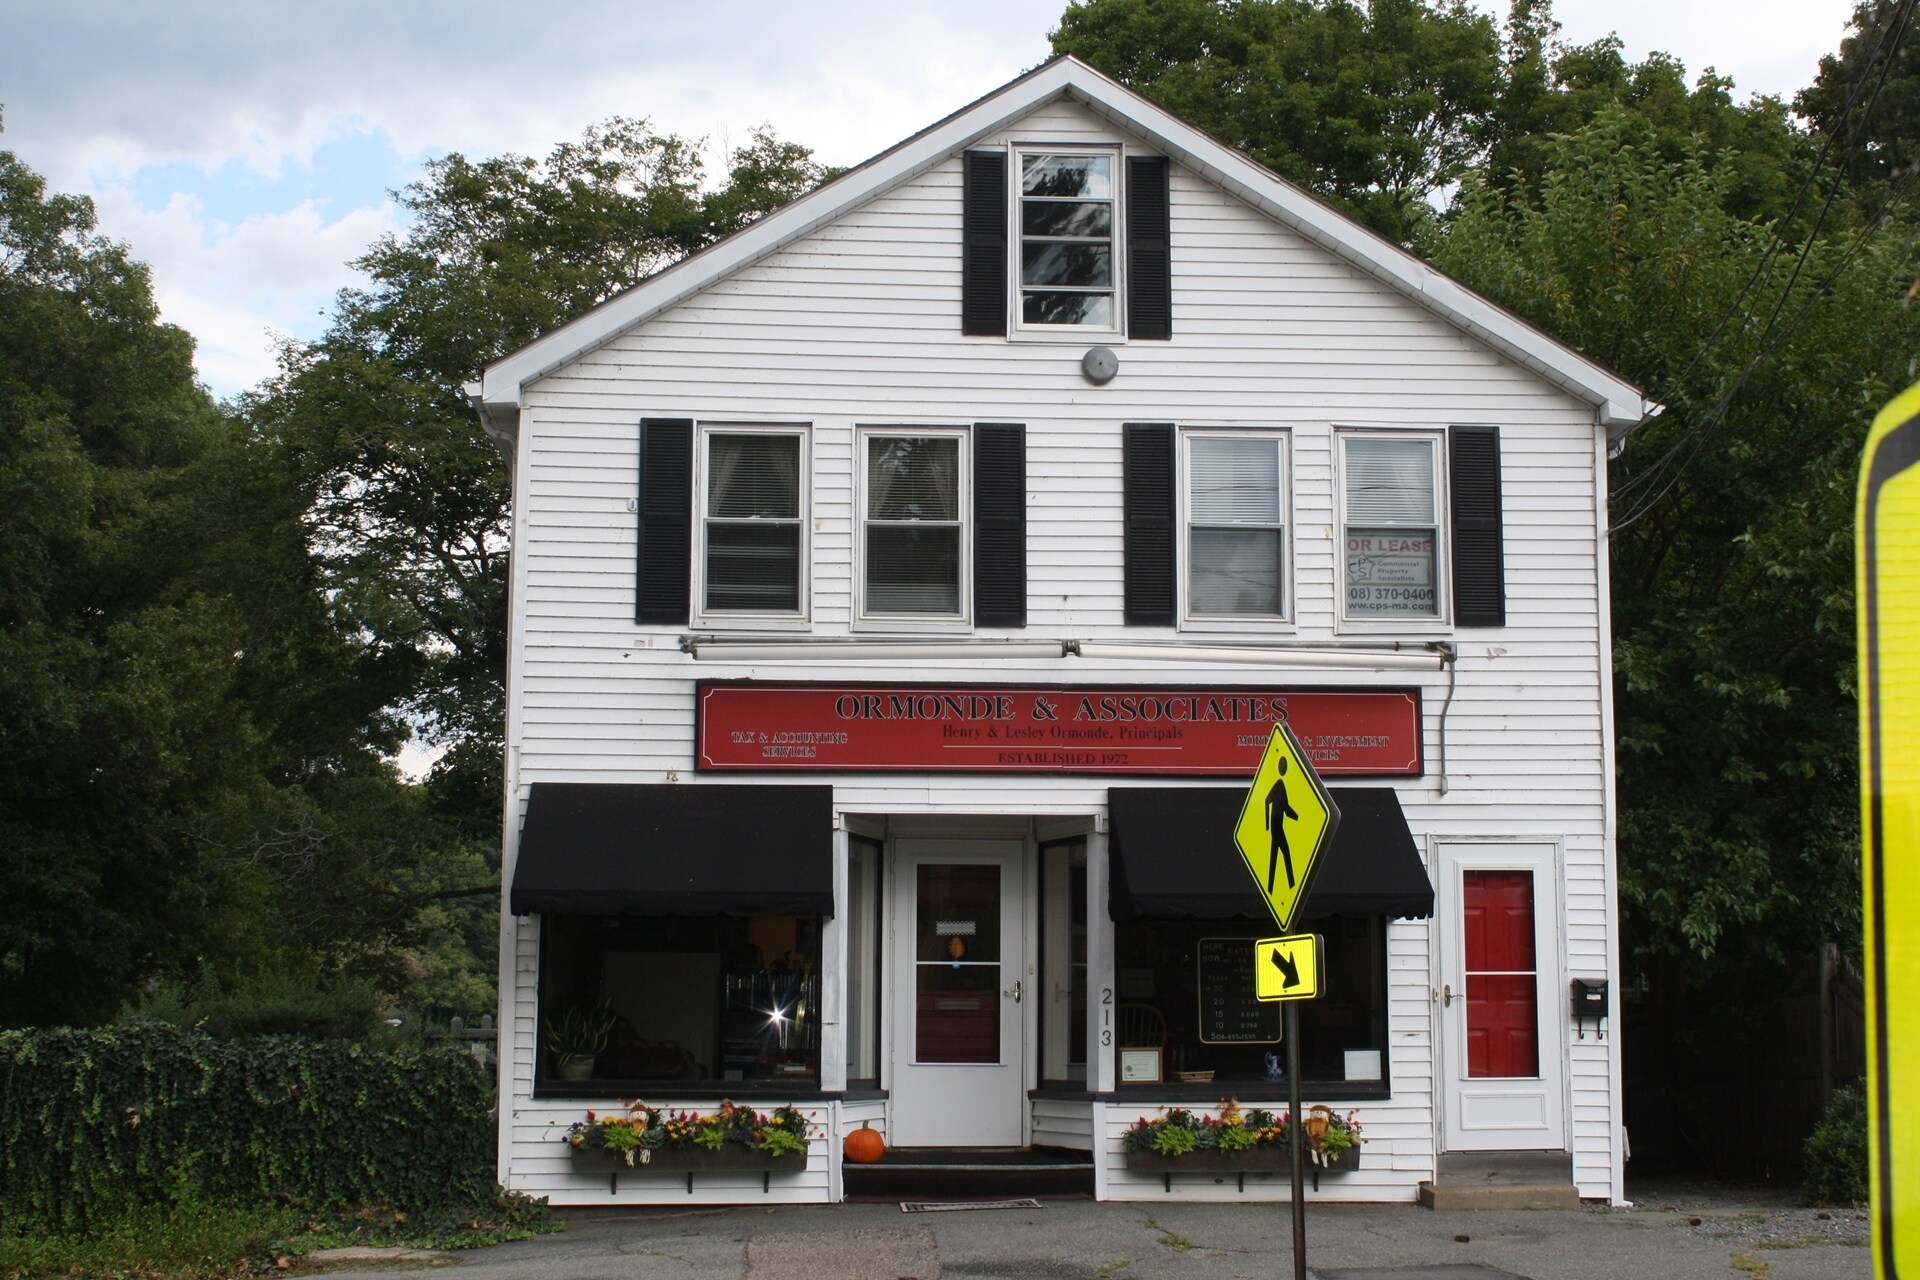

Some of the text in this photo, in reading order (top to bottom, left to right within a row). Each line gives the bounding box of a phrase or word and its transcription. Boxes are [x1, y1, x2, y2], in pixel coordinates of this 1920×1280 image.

[1347, 539, 1433, 552] OR LEASE
[1348, 587, 1434, 600] 08) 370-0400
[1347, 602, 1434, 612] ww.cps-ma.com
[834, 694, 1289, 722] ORMONDE & ASSOCIATES
[731, 731, 849, 744] TAX & ACCOUNTING
[943, 724, 1184, 742] Henry & Lesley Ormonde, Principals
[1303, 736, 1313, 747] &
[1316, 735, 1390, 747] INVESTMENT
[762, 746, 816, 758] SERVICES
[998, 752, 1128, 765] ESTABLISHED 1972
[1306, 749, 1340, 761] VICES
[1101, 987, 1112, 1046] 213
[1215, 1021, 1224, 1029] 10
